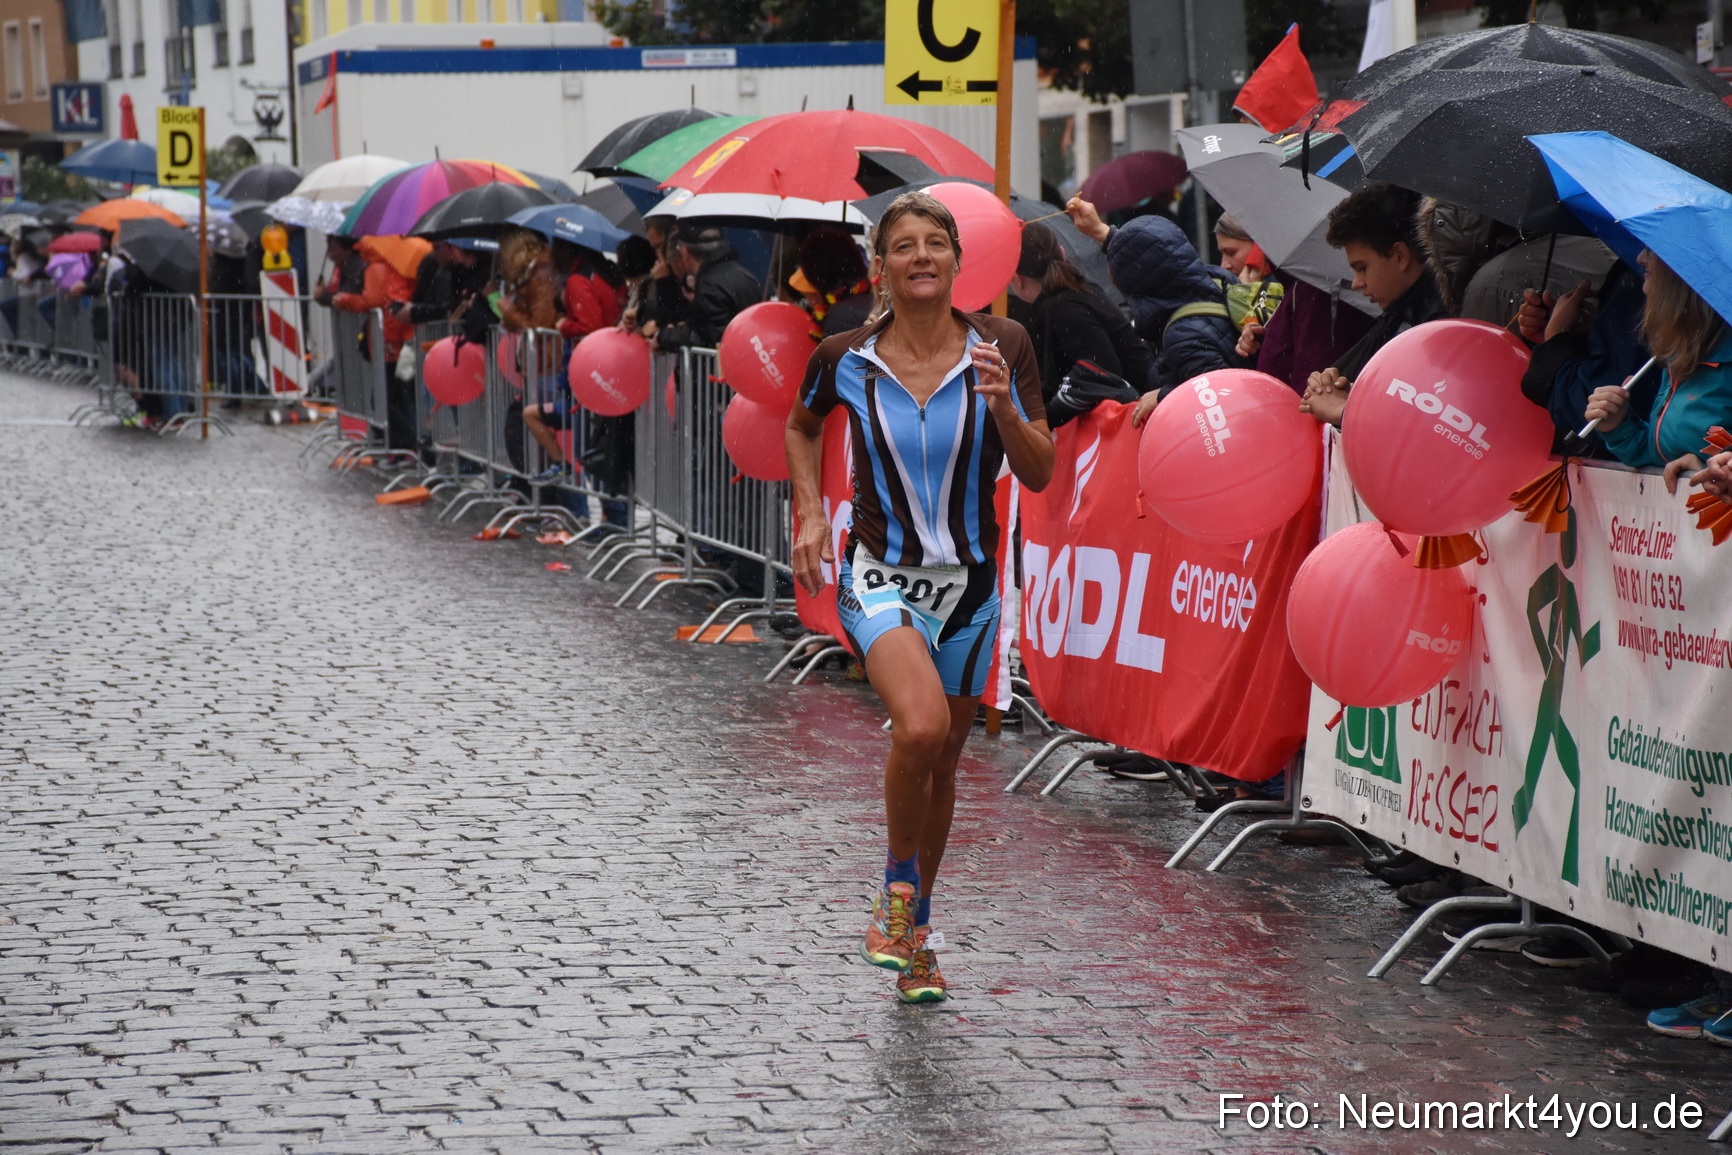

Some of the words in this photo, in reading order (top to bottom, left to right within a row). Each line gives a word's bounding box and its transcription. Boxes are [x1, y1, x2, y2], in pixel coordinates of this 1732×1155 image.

[917, 0, 982, 63] C
[161, 109, 199, 124] Block
[170, 131, 193, 167] D
[1609, 515, 1676, 561] Service-Line:
[1668, 574, 1685, 611] 52
